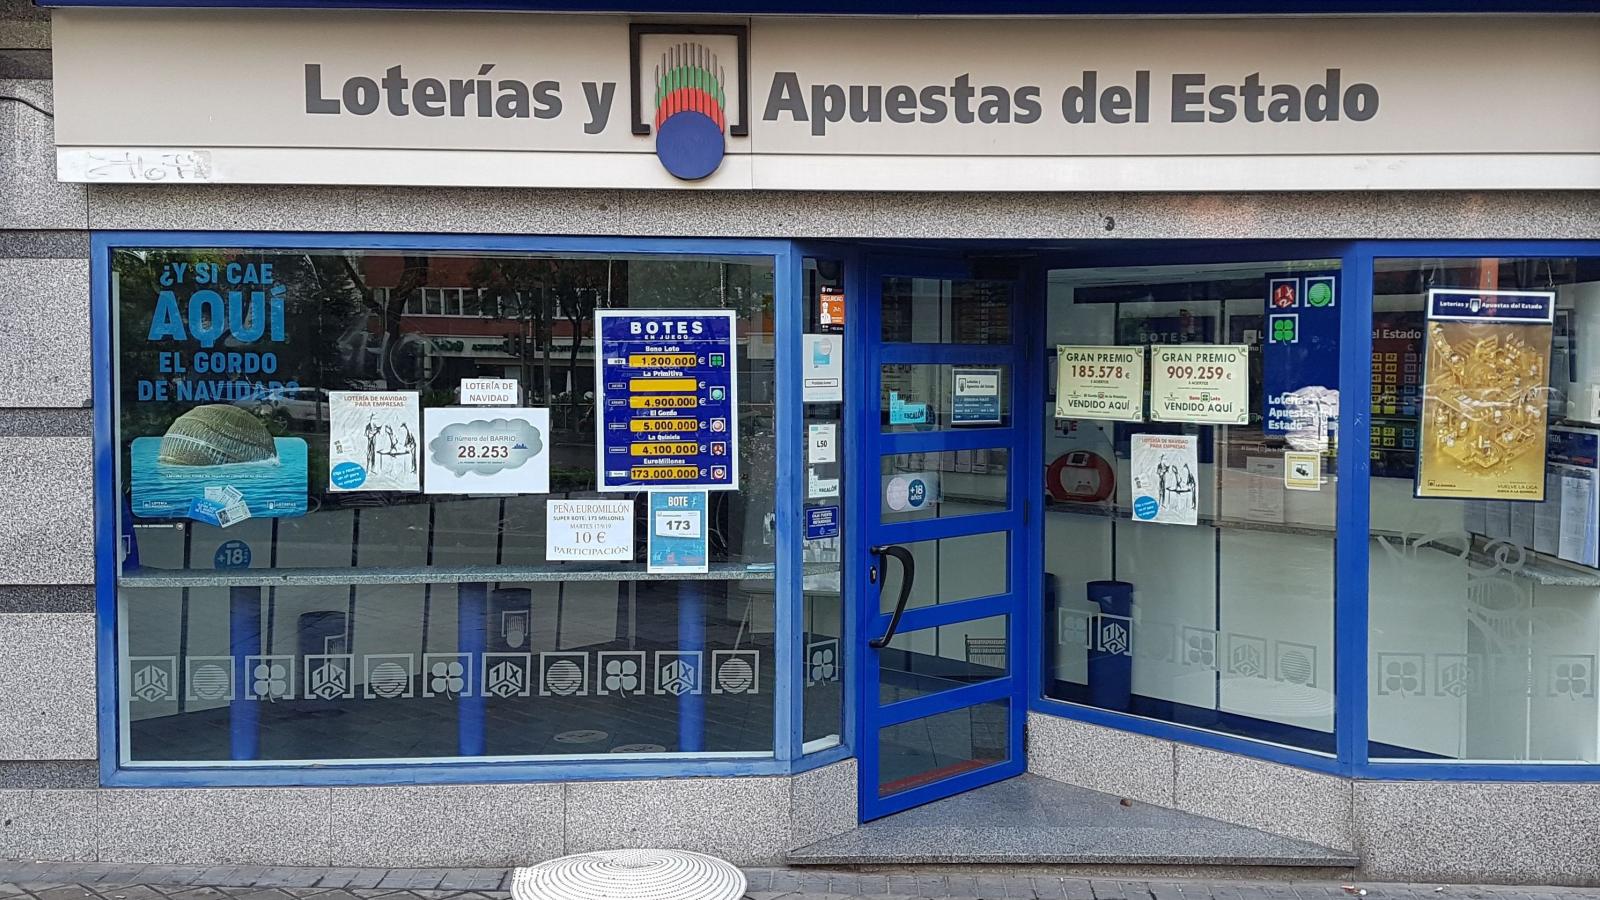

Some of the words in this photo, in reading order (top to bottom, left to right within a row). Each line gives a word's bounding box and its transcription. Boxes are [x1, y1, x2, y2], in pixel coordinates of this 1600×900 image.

[305, 64, 562, 119] Loterías
[582, 82, 616, 134] y
[762, 72, 1042, 136] Apuestas
[1062, 71, 1150, 124] del
[1171, 68, 1380, 123] Estado
[195, 263, 218, 284] SI
[226, 263, 273, 285] CAE
[148, 284, 287, 348] AQUÍ
[630, 321, 703, 334] BOTES
[1139, 333, 1188, 342] BOTES
[1383, 329, 1421, 339] Estado
[159, 352, 186, 373] EL
[194, 352, 277, 373] GORDO
[641, 358, 695, 366] 1.200.000
[1066, 353, 1095, 362] GRAN
[1097, 353, 1133, 363] PREMIO
[1162, 353, 1193, 363] GRAN
[1196, 353, 1236, 363] PREMIO
[1071, 365, 1123, 379] 185.578
[1167, 366, 1224, 380] 909.259
[1226, 372, 1231, 380] €
[138, 380, 168, 401] DE
[466, 381, 500, 390] LOTERÍA
[502, 382, 513, 390] DE
[469, 394, 508, 402] NAVIDAD
[644, 398, 695, 407] 4.900.000
[1068, 400, 1105, 408] VENDIDO
[1109, 400, 1130, 410] AQUÍ
[1164, 402, 1205, 411] VENDIDO
[1208, 402, 1233, 412] AQUÍ
[643, 421, 696, 430] 5.000.000
[817, 440, 827, 448] L50
[458, 445, 508, 458] 28.253
[643, 445, 696, 455] 4.100.000
[632, 469, 697, 479] 173.000.000
[910, 485, 923, 495] +18
[668, 496, 688, 506] BOTE
[553, 503, 574, 513] PEÑA
[576, 503, 630, 513] EUROMILLÓN
[666, 520, 690, 530] 173
[575, 532, 591, 543] 10
[597, 532, 606, 543] €
[554, 545, 629, 556] PARTICIPACIÓN
[217, 548, 243, 566] +18
